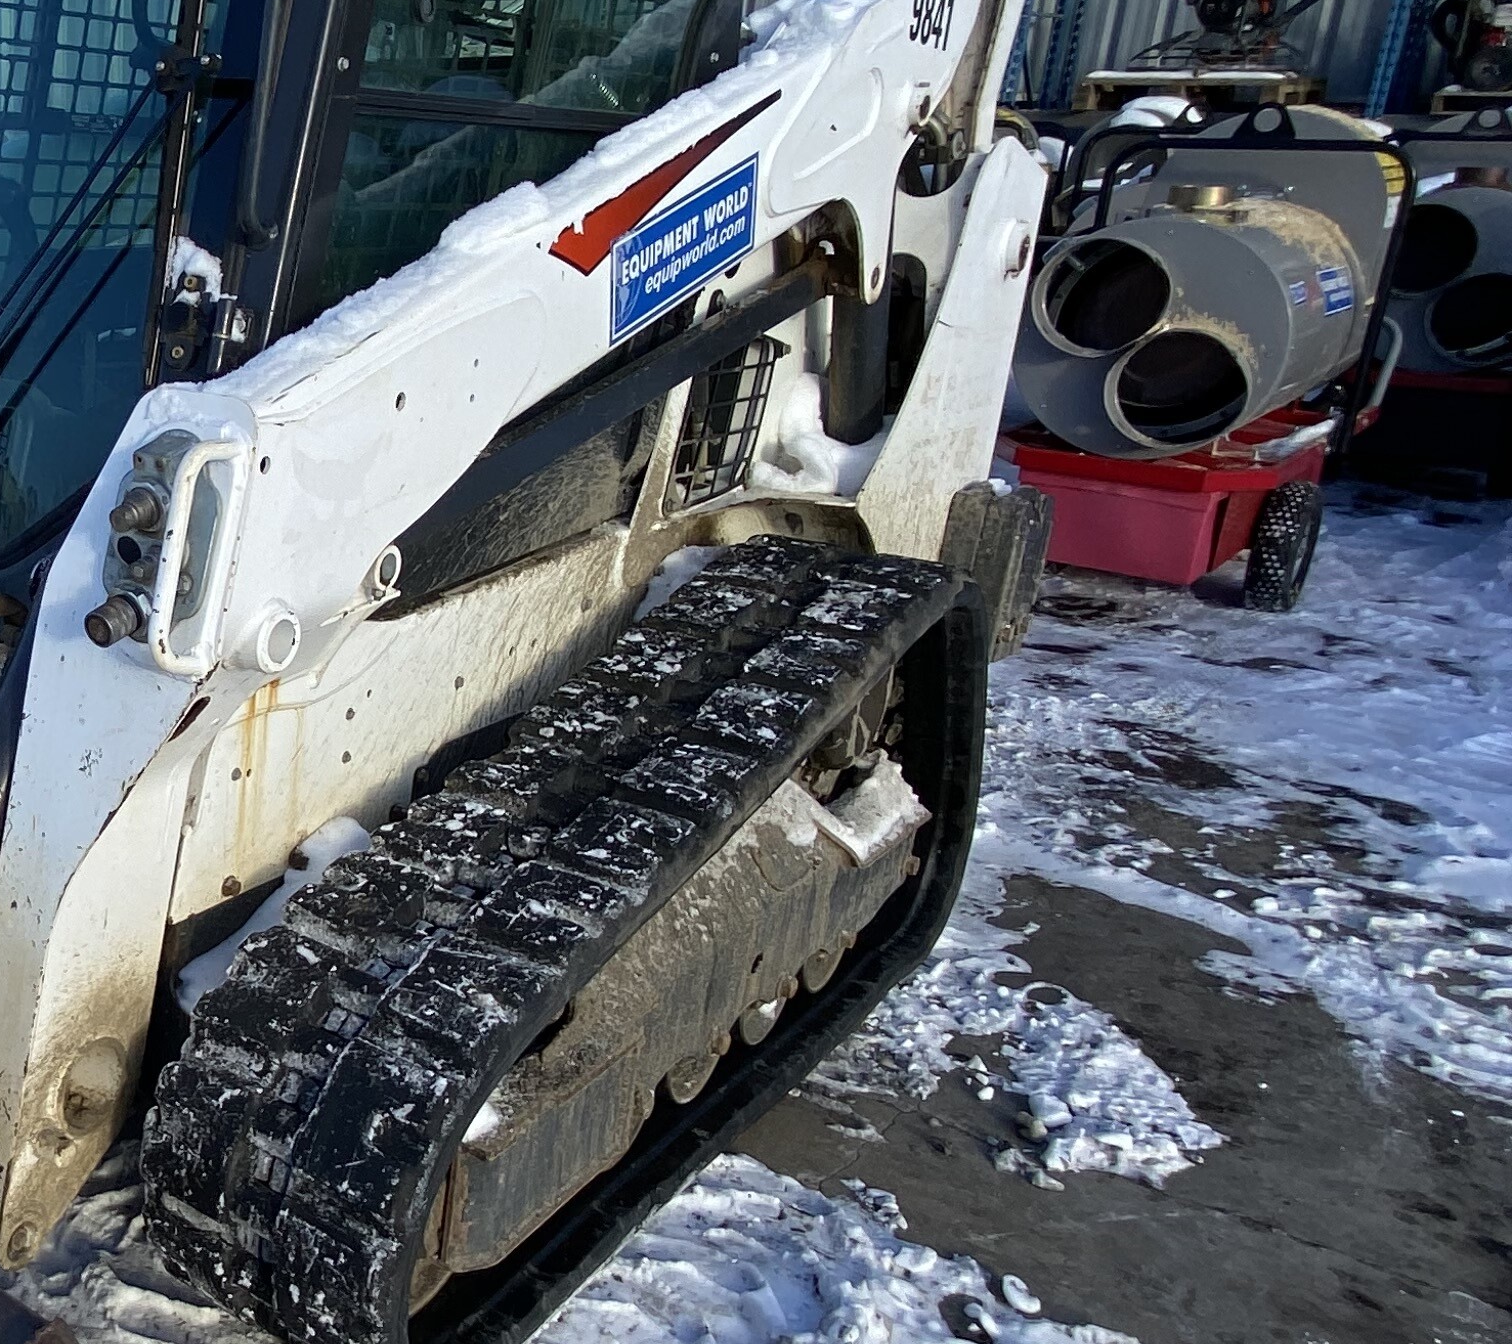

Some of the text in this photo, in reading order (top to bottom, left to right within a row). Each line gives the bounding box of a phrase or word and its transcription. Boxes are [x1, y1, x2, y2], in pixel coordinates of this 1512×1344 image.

[621, 185, 749, 285] EQUIPMENT WORLD
[644, 216, 746, 294] equipworld.com
